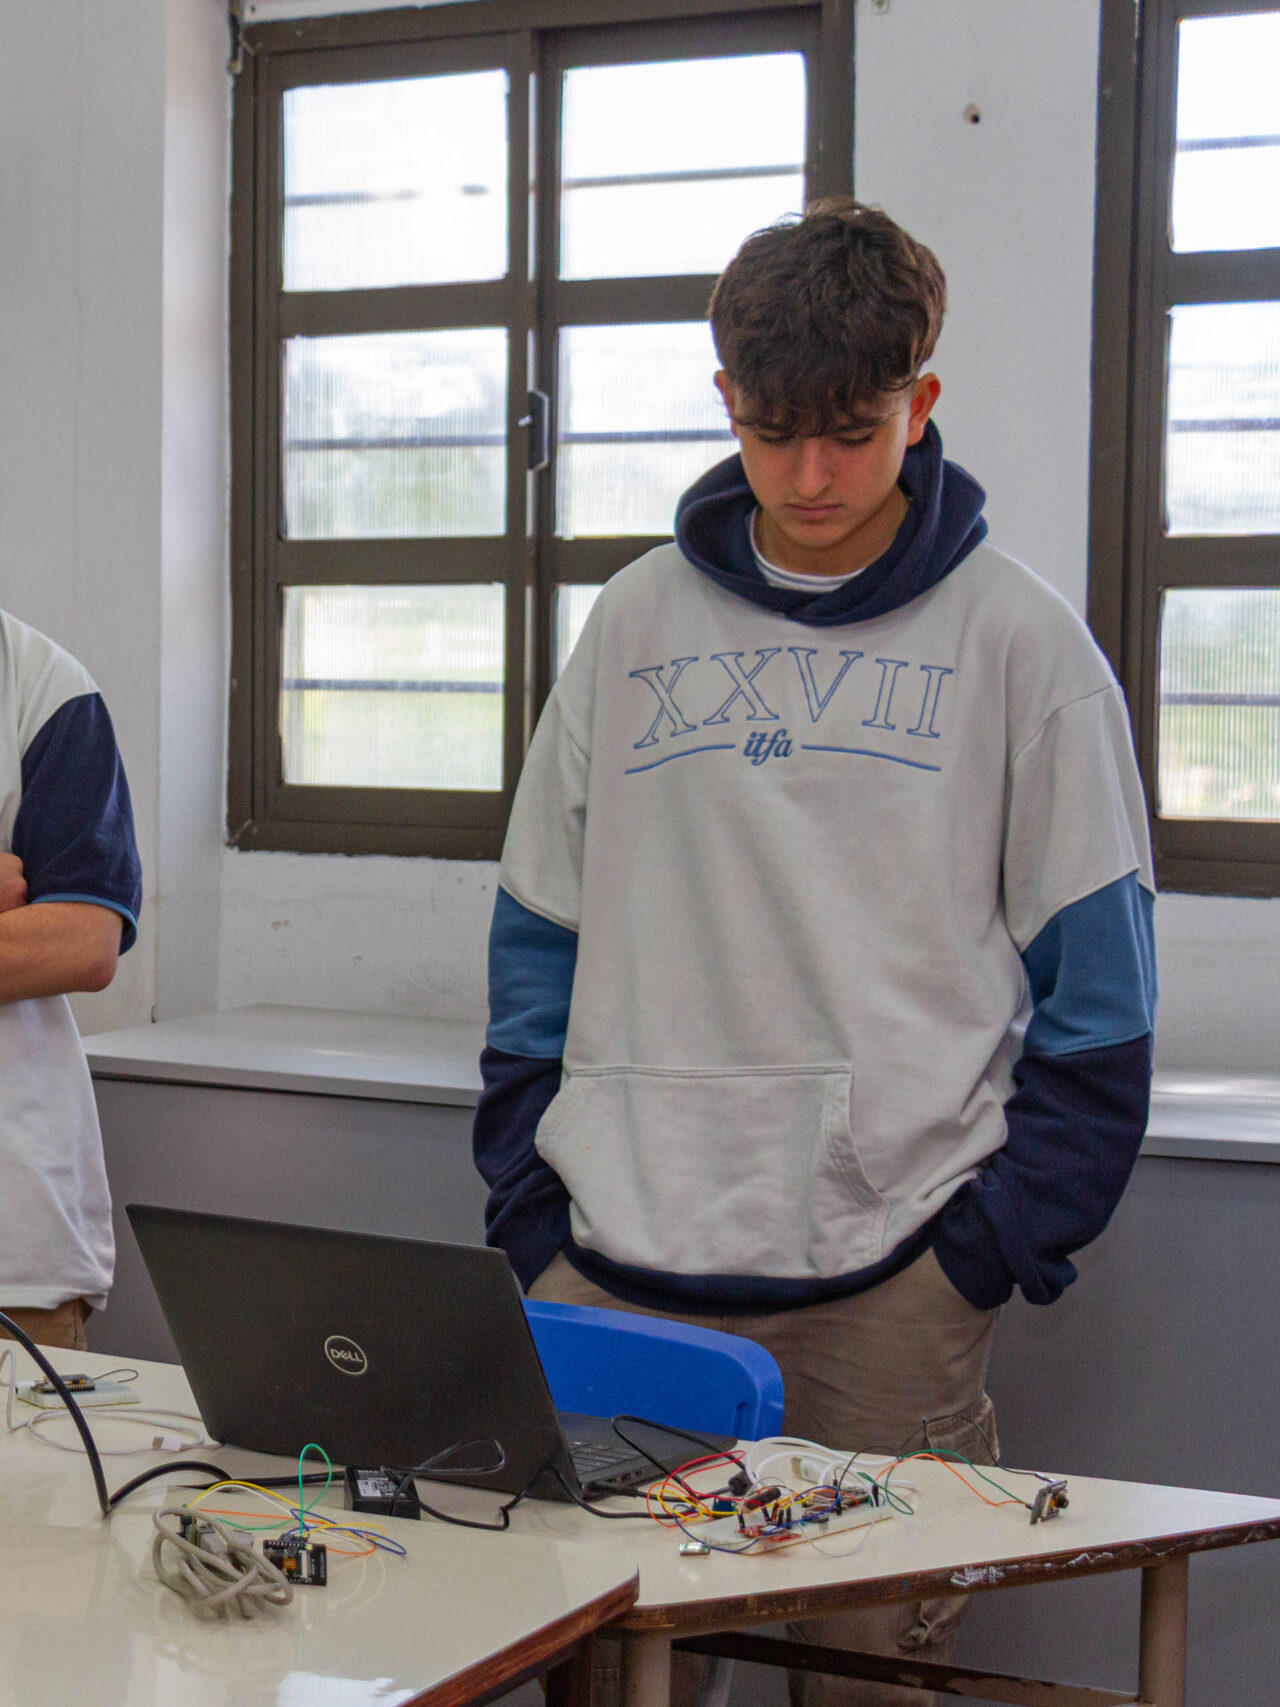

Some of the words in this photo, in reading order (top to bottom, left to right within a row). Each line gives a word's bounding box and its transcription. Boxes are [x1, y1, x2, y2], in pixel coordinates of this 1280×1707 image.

[628, 646, 954, 749] XXVII
[743, 729, 794, 766] itfa
[330, 1348, 363, 1362] DELL
